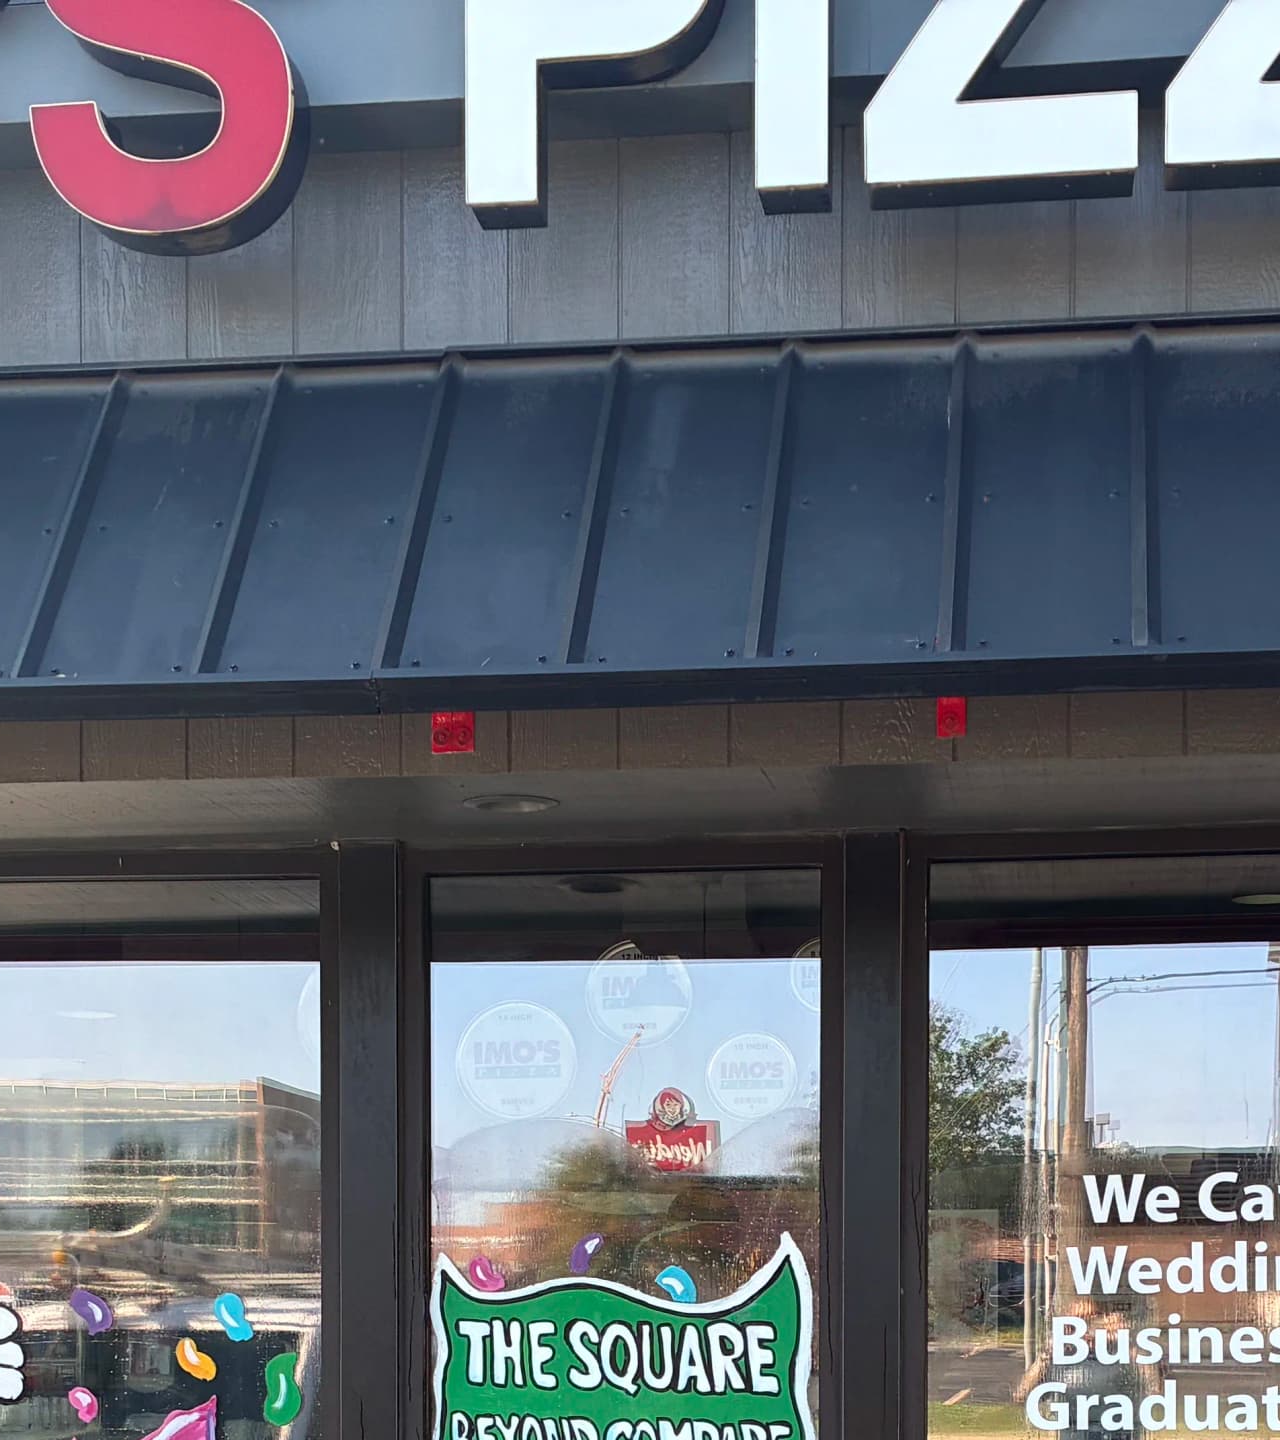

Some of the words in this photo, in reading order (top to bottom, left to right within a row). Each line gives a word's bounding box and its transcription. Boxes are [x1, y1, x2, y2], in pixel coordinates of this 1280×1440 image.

[473, 1040, 561, 1064] IMO'S
[1083, 1174, 1179, 1222] We
[459, 1319, 558, 1388] THE
[568, 1321, 780, 1395] SQUARE
